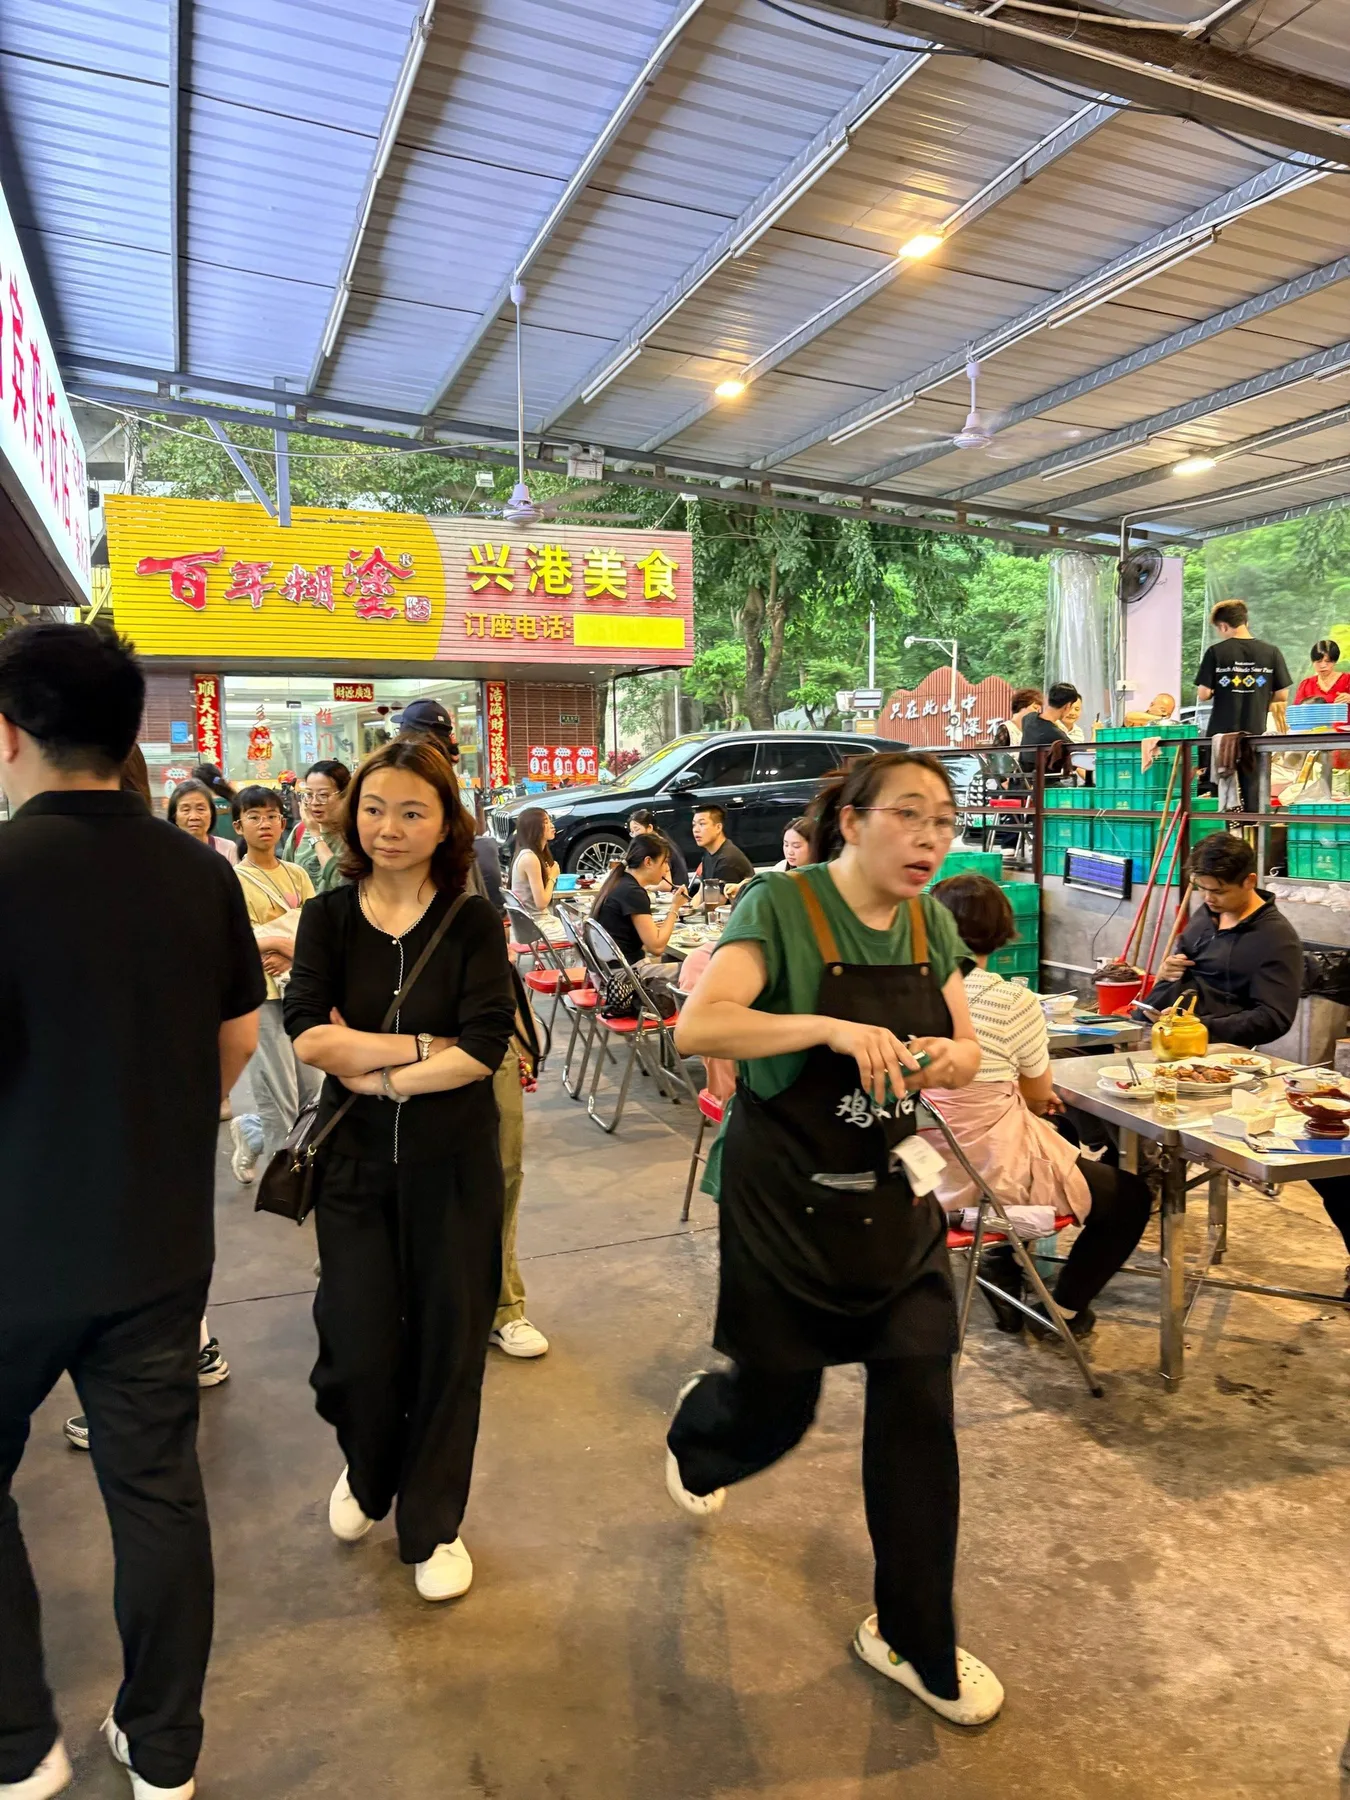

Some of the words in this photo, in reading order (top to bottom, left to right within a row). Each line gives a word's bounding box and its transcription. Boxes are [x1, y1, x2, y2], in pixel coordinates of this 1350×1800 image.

[467, 542, 679, 601] 兴港美食
[889, 693, 977, 720] 只在此山中
[944, 717, 1005, 740] 深不
